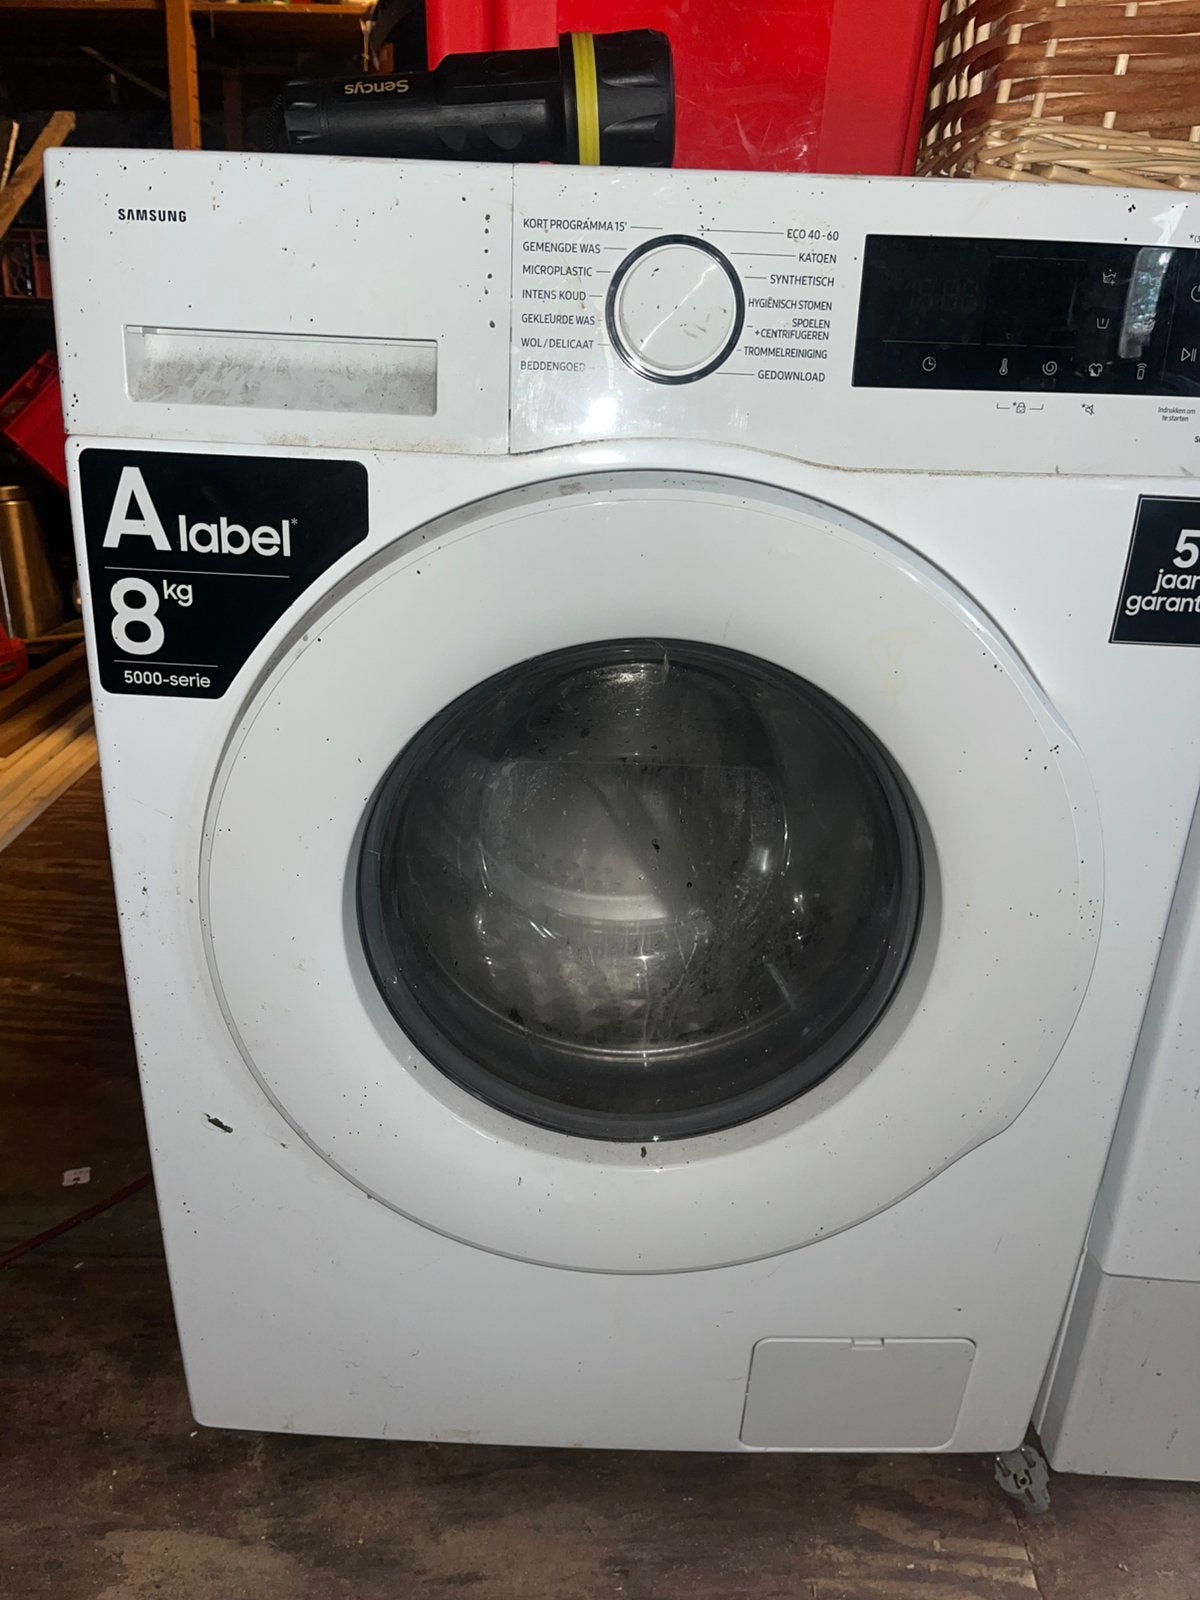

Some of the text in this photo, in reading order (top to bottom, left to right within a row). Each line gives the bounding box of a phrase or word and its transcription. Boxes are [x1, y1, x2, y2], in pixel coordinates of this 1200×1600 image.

[344, 80, 409, 94] Sencys
[118, 208, 187, 222] SAMSUNG
[523, 218, 548, 229] KORT
[550, 219, 613, 231] PROGRAMMA
[787, 229, 806, 239] ECO
[523, 241, 600, 254] GEMENGDE WAS
[799, 253, 837, 264] KATOEN
[522, 264, 592, 277] MICROPLASTIC
[770, 274, 835, 287] SYNTHETISCH
[522, 289, 587, 301] INTENS KOUD
[748, 297, 832, 311] HYGIËNISCH STOMEN
[521, 313, 596, 326] GEKLEURDE WAS
[792, 318, 831, 329] SPOELEN
[755, 329, 829, 340] +CENTRIFUGEREN
[744, 346, 828, 359] TROMMELREINIGING
[757, 370, 826, 382] GEDOWNLOAD
[1158, 406, 1186, 414] Indrukken
[102, 466, 172, 551] A
[1172, 529, 1200, 569] 5
[1152, 568, 1200, 594] jaar
[110, 577, 193, 655] 8 kg
[124, 670, 211, 688] 5000-serie
